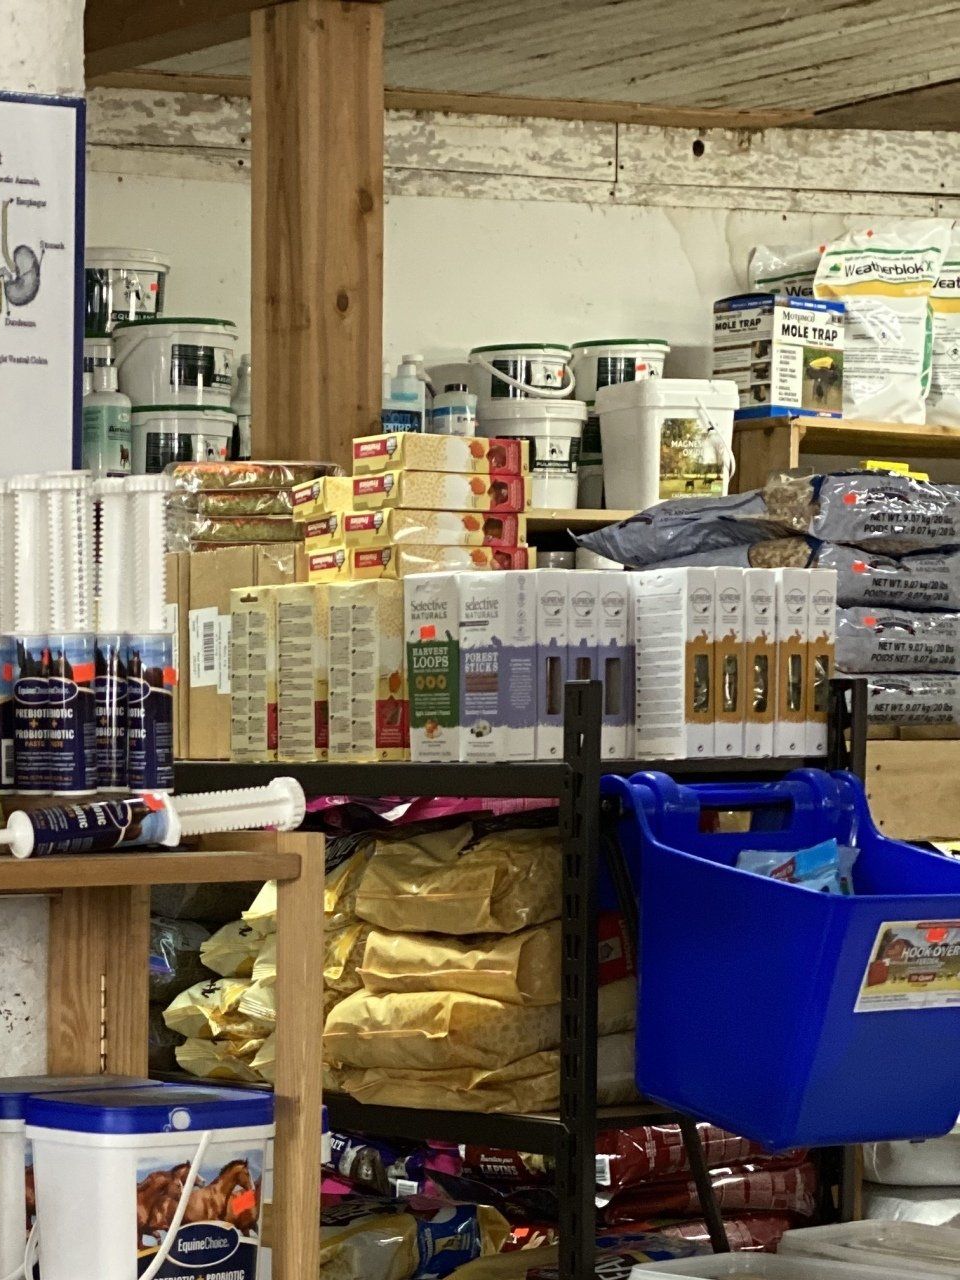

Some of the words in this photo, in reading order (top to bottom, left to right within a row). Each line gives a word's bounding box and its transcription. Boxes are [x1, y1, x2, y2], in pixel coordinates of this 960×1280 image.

[844, 260, 924, 278] Weatherblok
[715, 320, 737, 332] MOLE
[739, 318, 762, 328] TRAP
[782, 323, 809, 338] MOLE
[812, 328, 838, 342] TRAP
[872, 578, 889, 587] NET
[410, 600, 448, 611] Selective
[410, 612, 448, 620] NATURALS
[465, 610, 498, 619] NATURALS
[412, 647, 448, 656] HARVEST
[878, 642, 894, 651] NET
[909, 642, 926, 652] 9.07
[412, 656, 449, 668] LOOPS
[465, 652, 498, 662] FOREST
[465, 662, 498, 672] STICKS
[874, 704, 890, 712] NET
[901, 948, 931, 959] HOOK
